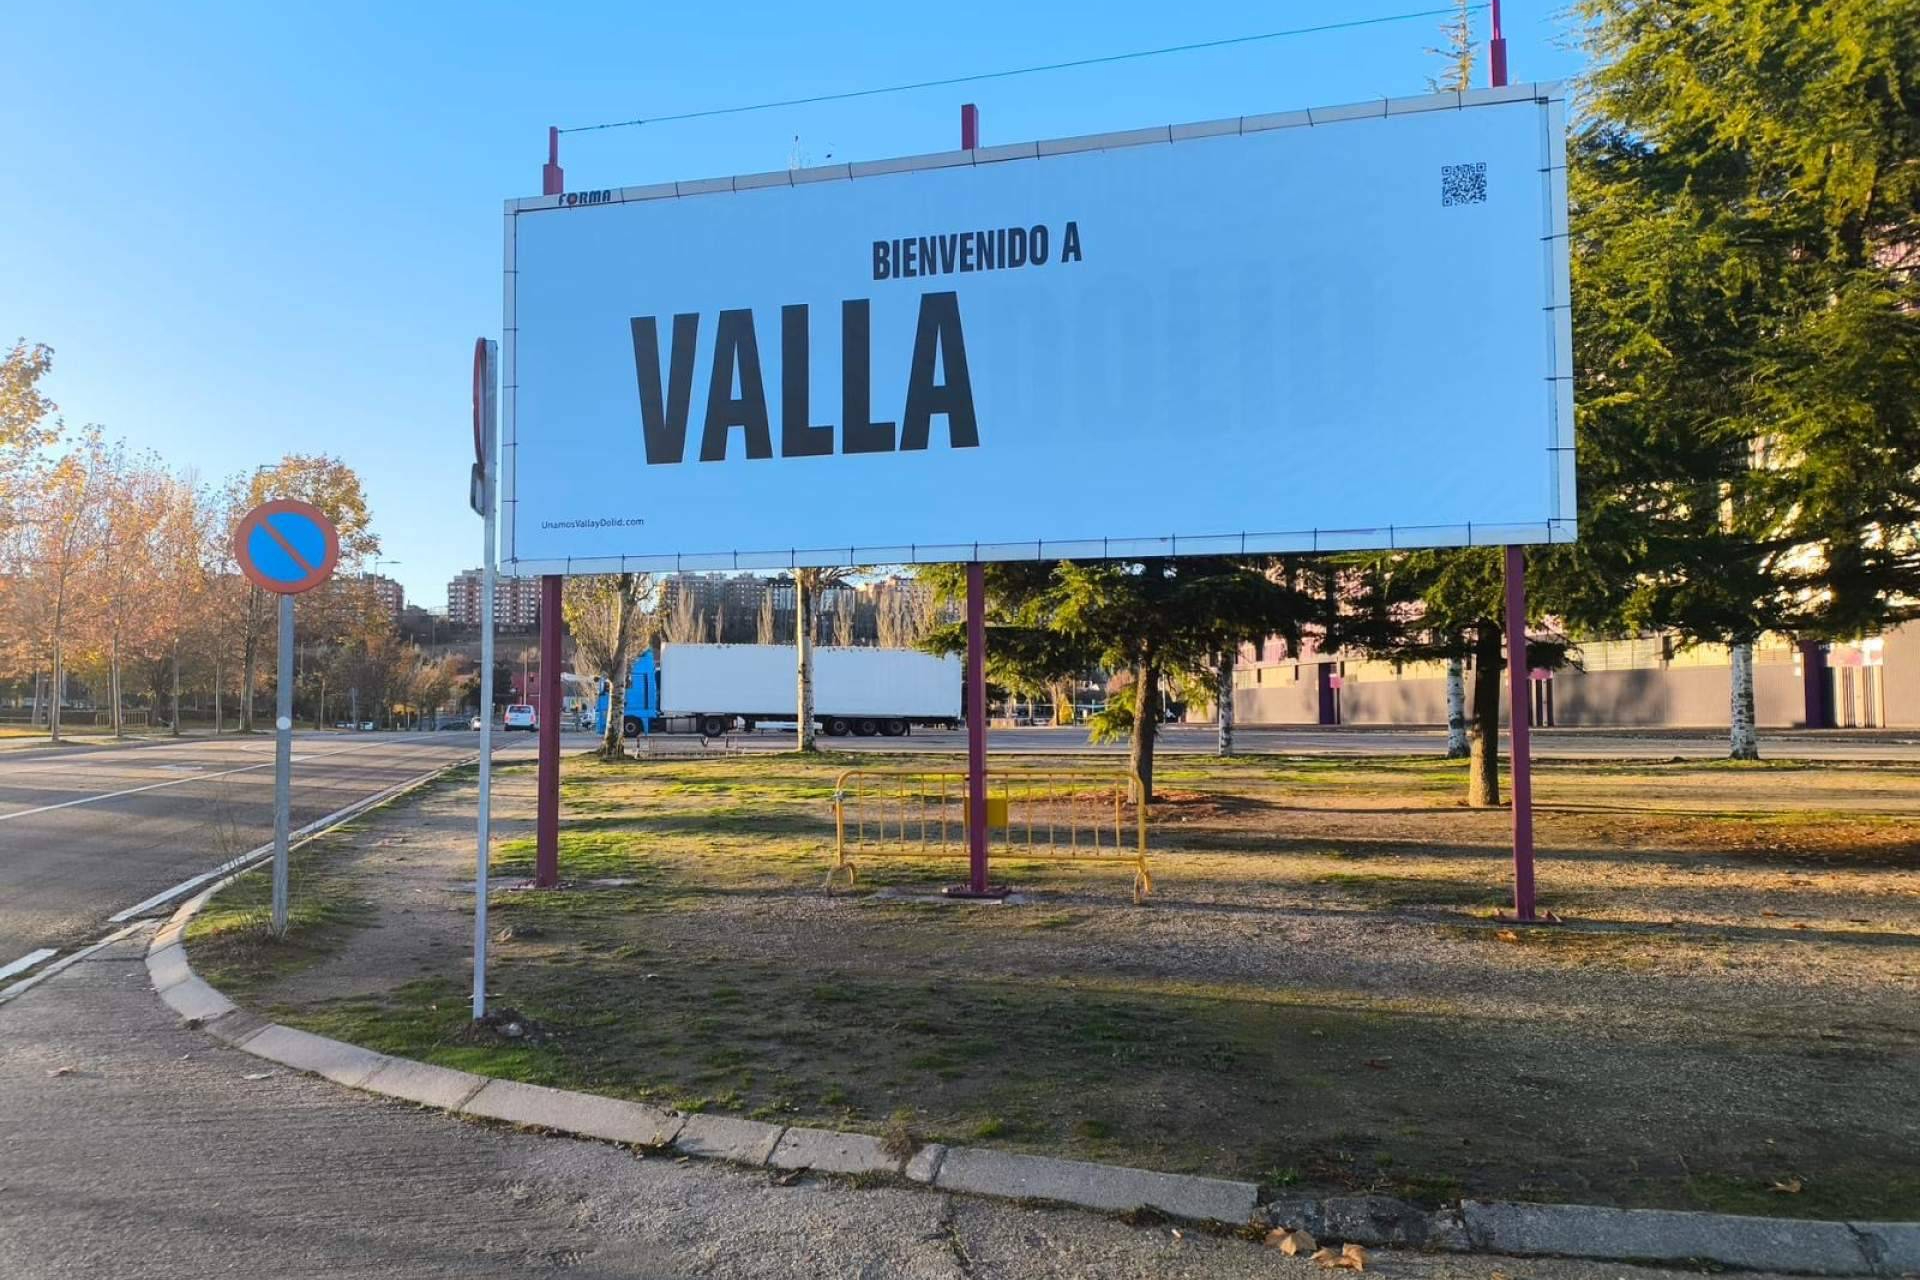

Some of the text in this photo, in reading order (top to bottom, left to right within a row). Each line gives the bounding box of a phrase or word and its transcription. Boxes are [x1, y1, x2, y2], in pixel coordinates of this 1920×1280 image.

[558, 189, 612, 207] FORMA
[873, 221, 1083, 281] BIENVENIDO A
[630, 291, 980, 465] VALLA
[541, 517, 645, 530] UnamosVallayDolid.com
